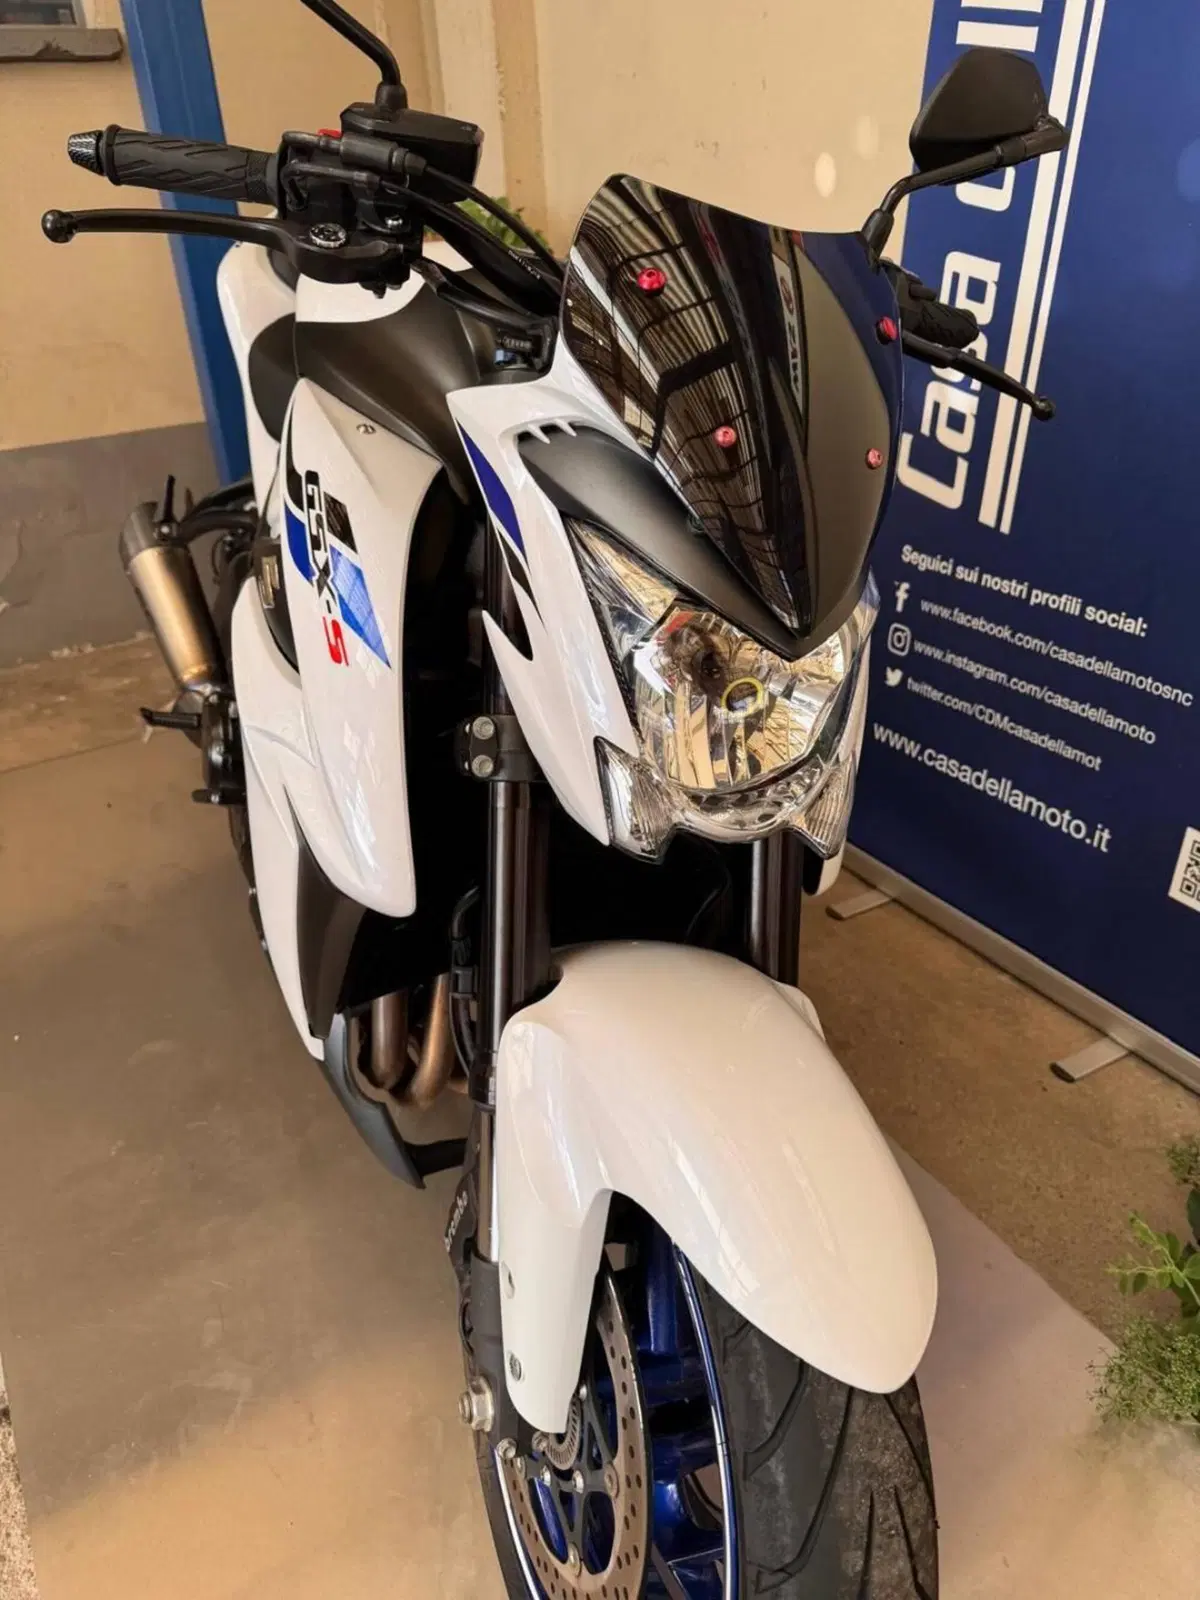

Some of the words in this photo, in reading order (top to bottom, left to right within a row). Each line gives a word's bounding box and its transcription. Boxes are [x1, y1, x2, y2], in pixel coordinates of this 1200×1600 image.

[901, 545, 953, 575] Seguici
[955, 563, 980, 584] sui
[981, 574, 1029, 600] nostri
[1030, 588, 1083, 617] profili
[1084, 606, 1148, 638] social:
[914, 640, 1156, 745] www.instagram.com/casadellamoto
[920, 599, 1194, 707] www.facebook.com/casadellamotosnc
[907, 676, 1102, 771] twitter.com/CDMcasadellamot
[873, 722, 1112, 853] www.casadellamoto.it
